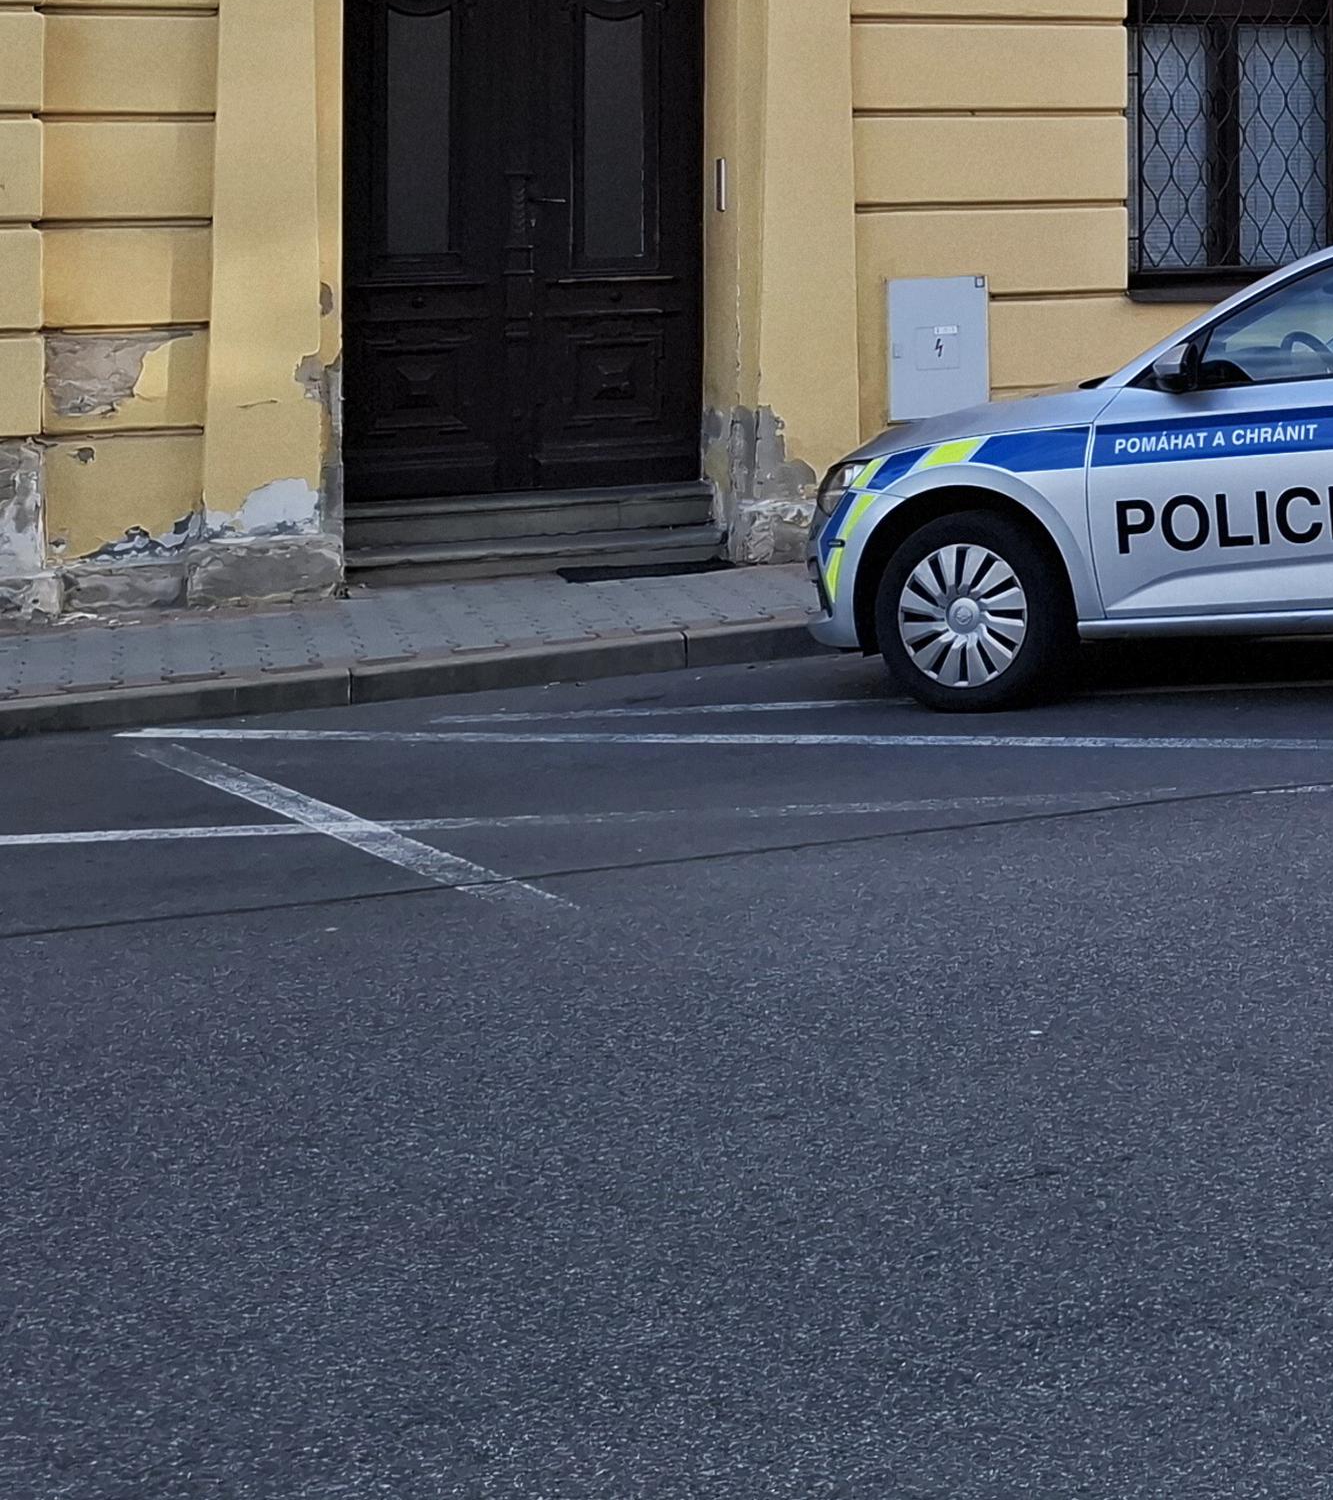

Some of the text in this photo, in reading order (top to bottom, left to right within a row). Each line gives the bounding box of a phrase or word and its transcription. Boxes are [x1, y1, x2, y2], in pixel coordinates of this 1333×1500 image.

[1113, 421, 1319, 455] POMÁHAT A CHRÁNIT
